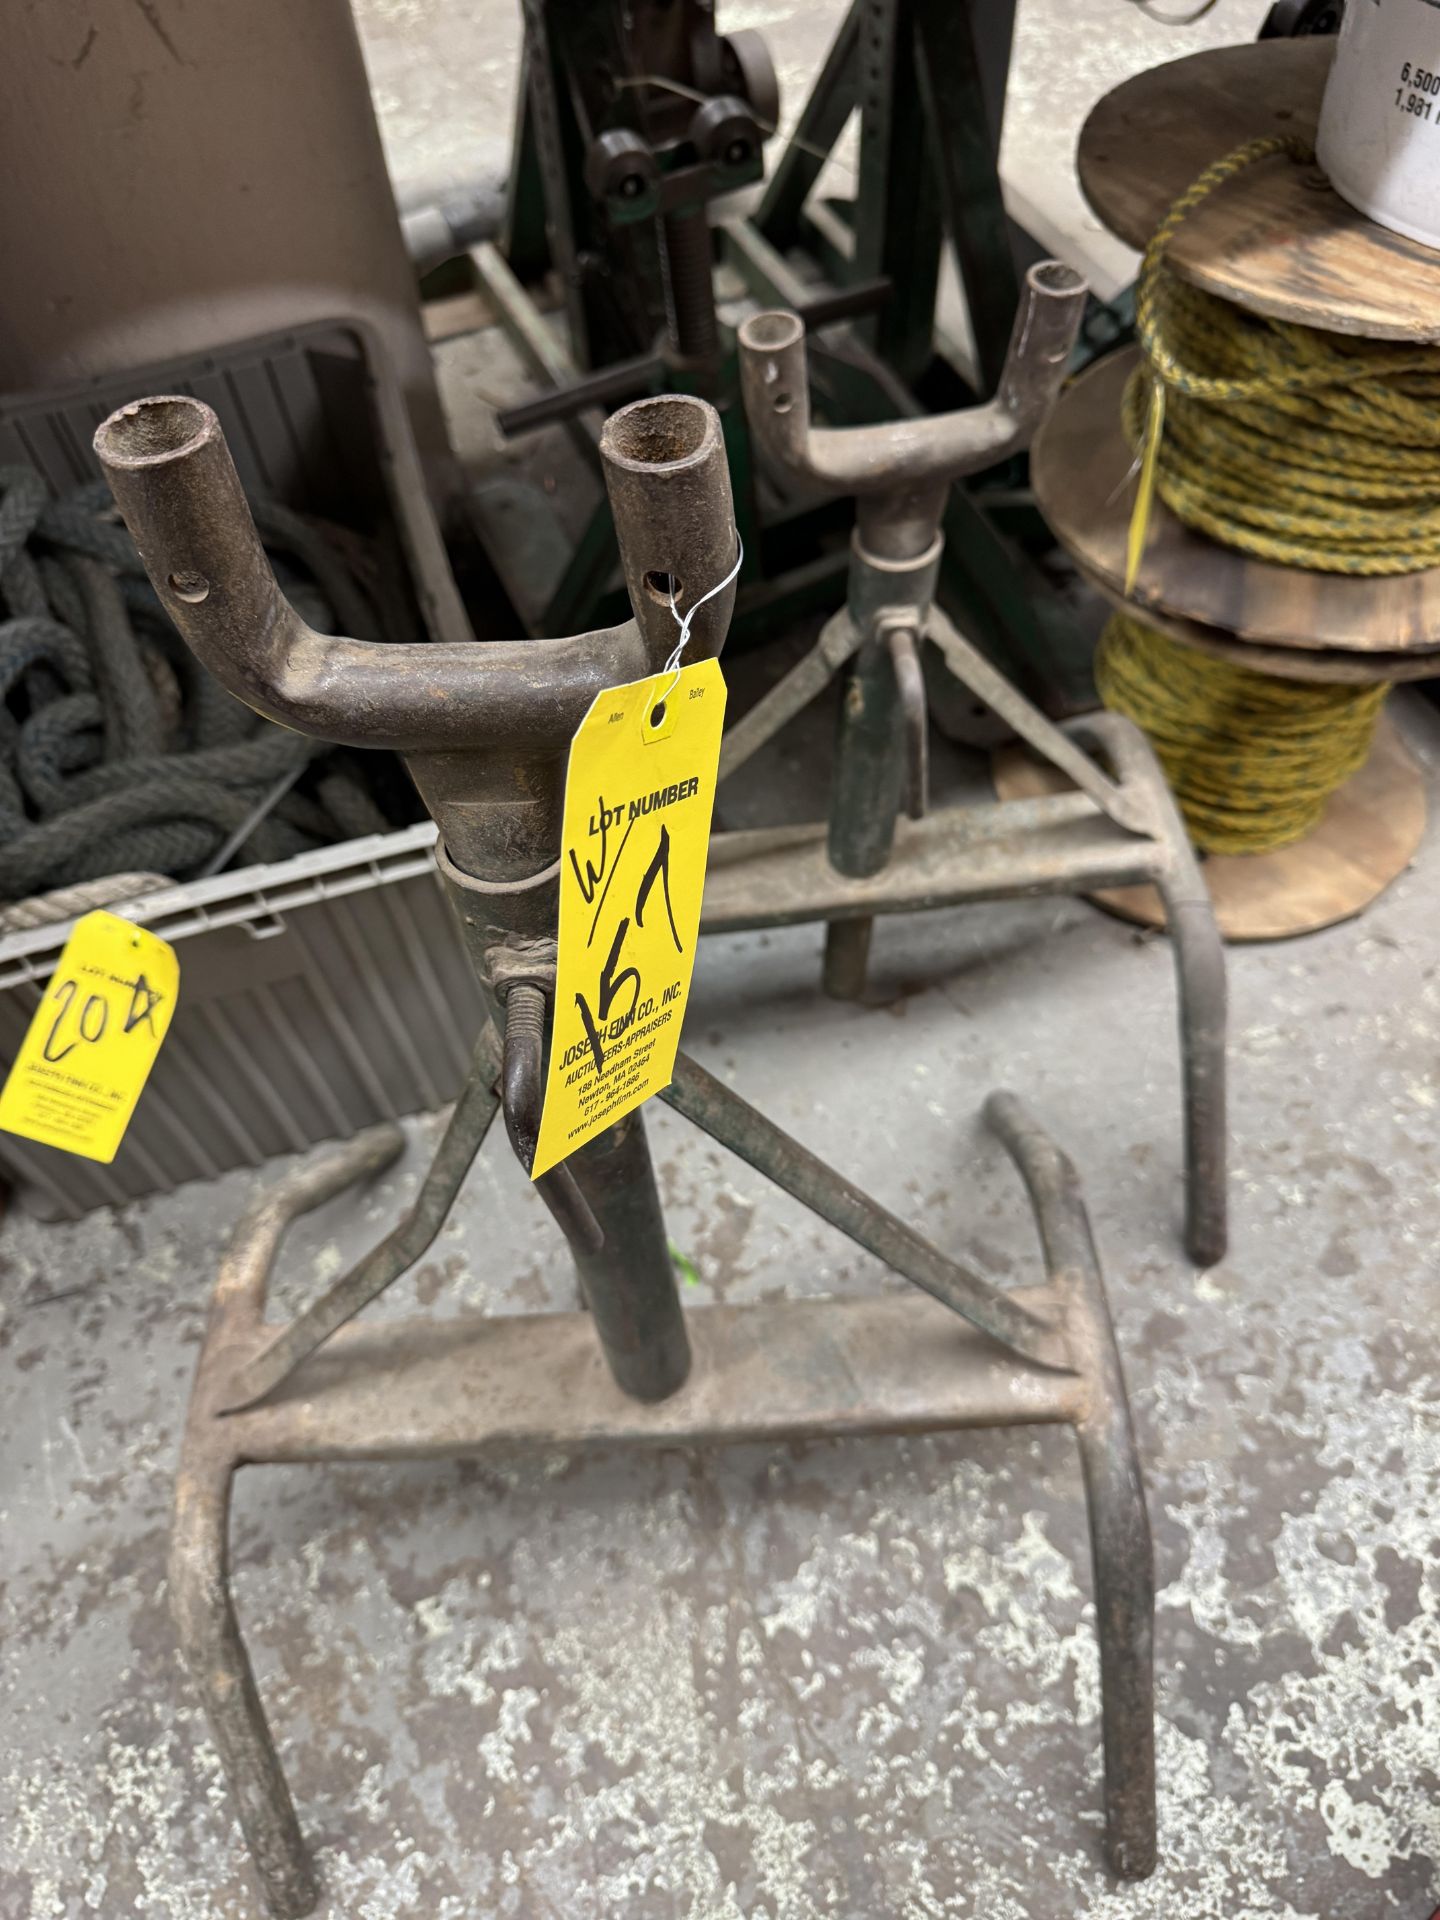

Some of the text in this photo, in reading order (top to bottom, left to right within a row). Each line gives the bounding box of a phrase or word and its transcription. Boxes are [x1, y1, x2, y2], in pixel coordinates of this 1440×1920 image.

[1394, 88, 1432, 120] 1,981
[1401, 62, 1440, 96] 6,500
[588, 776, 699, 836] LOT NUMBER
[559, 1025, 607, 1070] JOSEH
[637, 997, 659, 1021] CO.,
[661, 981, 682, 1007] INC.
[565, 1009, 672, 1088] AUCTIOEERS-APPRAISERS
[577, 1038, 657, 1096] 188 Needham Street
[577, 1082, 611, 1109] Newton,
[613, 1069, 626, 1085] MA
[567, 1078, 650, 1140] www.josephfinn.com
[584, 1099, 600, 1116] 617
